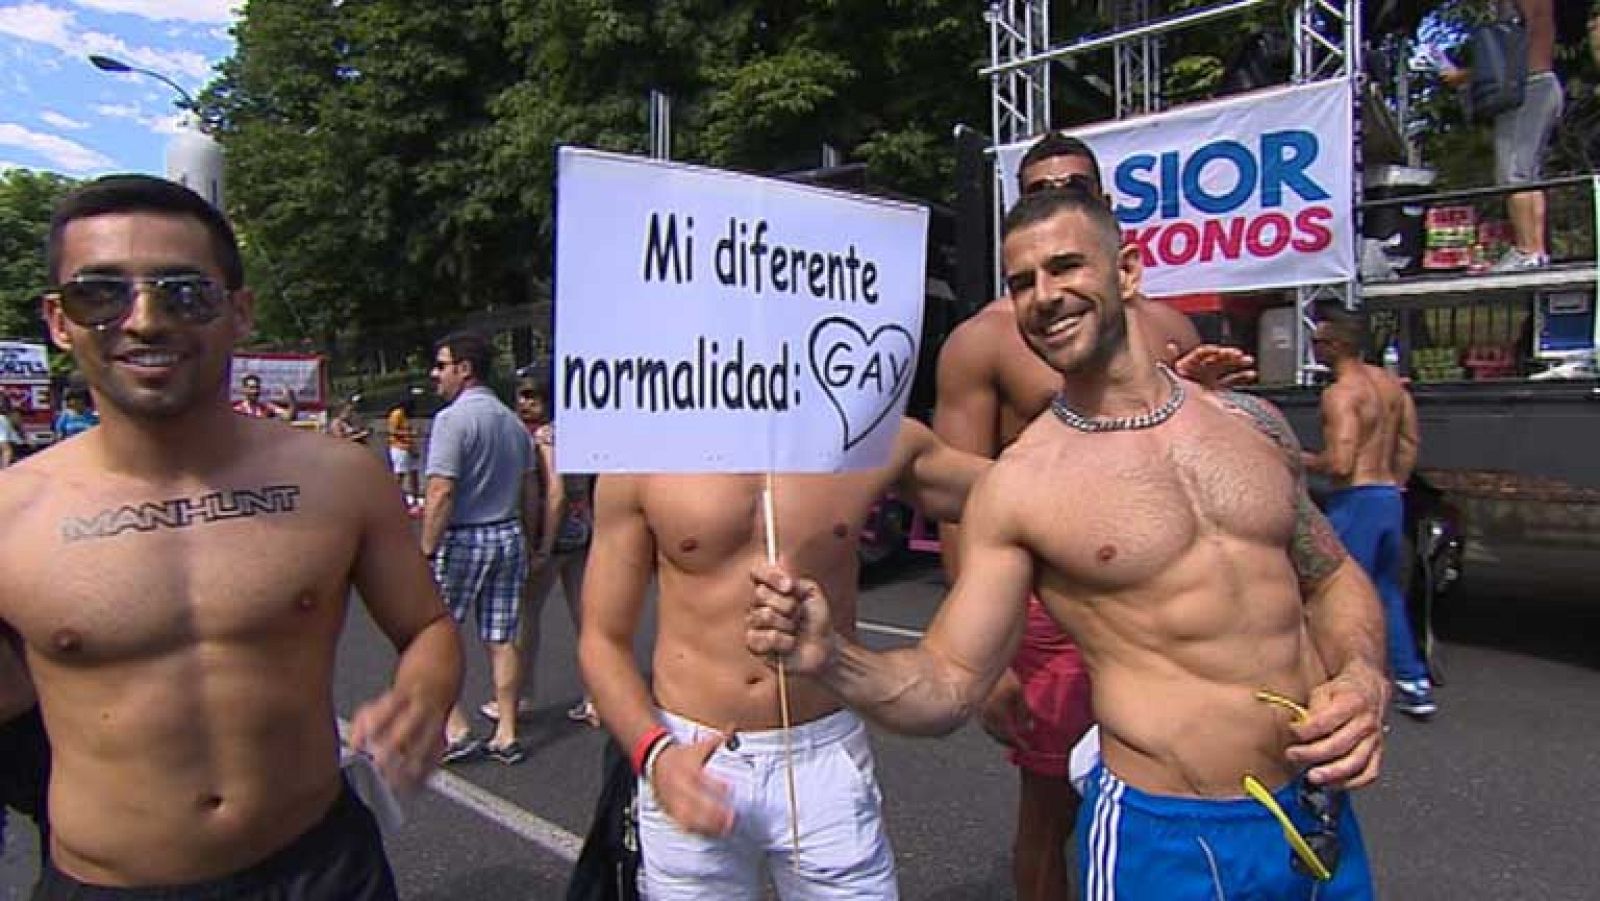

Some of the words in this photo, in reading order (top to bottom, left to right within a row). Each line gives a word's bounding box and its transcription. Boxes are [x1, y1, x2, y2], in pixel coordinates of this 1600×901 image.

[1115, 130, 1332, 223] SIOR
[644, 212, 695, 284] Mi
[714, 217, 879, 304] diferente
[1123, 207, 1333, 267] KONOS
[563, 337, 800, 411] normalidad:
[824, 341, 911, 395] GAY
[61, 485, 301, 539] MANHUNT
